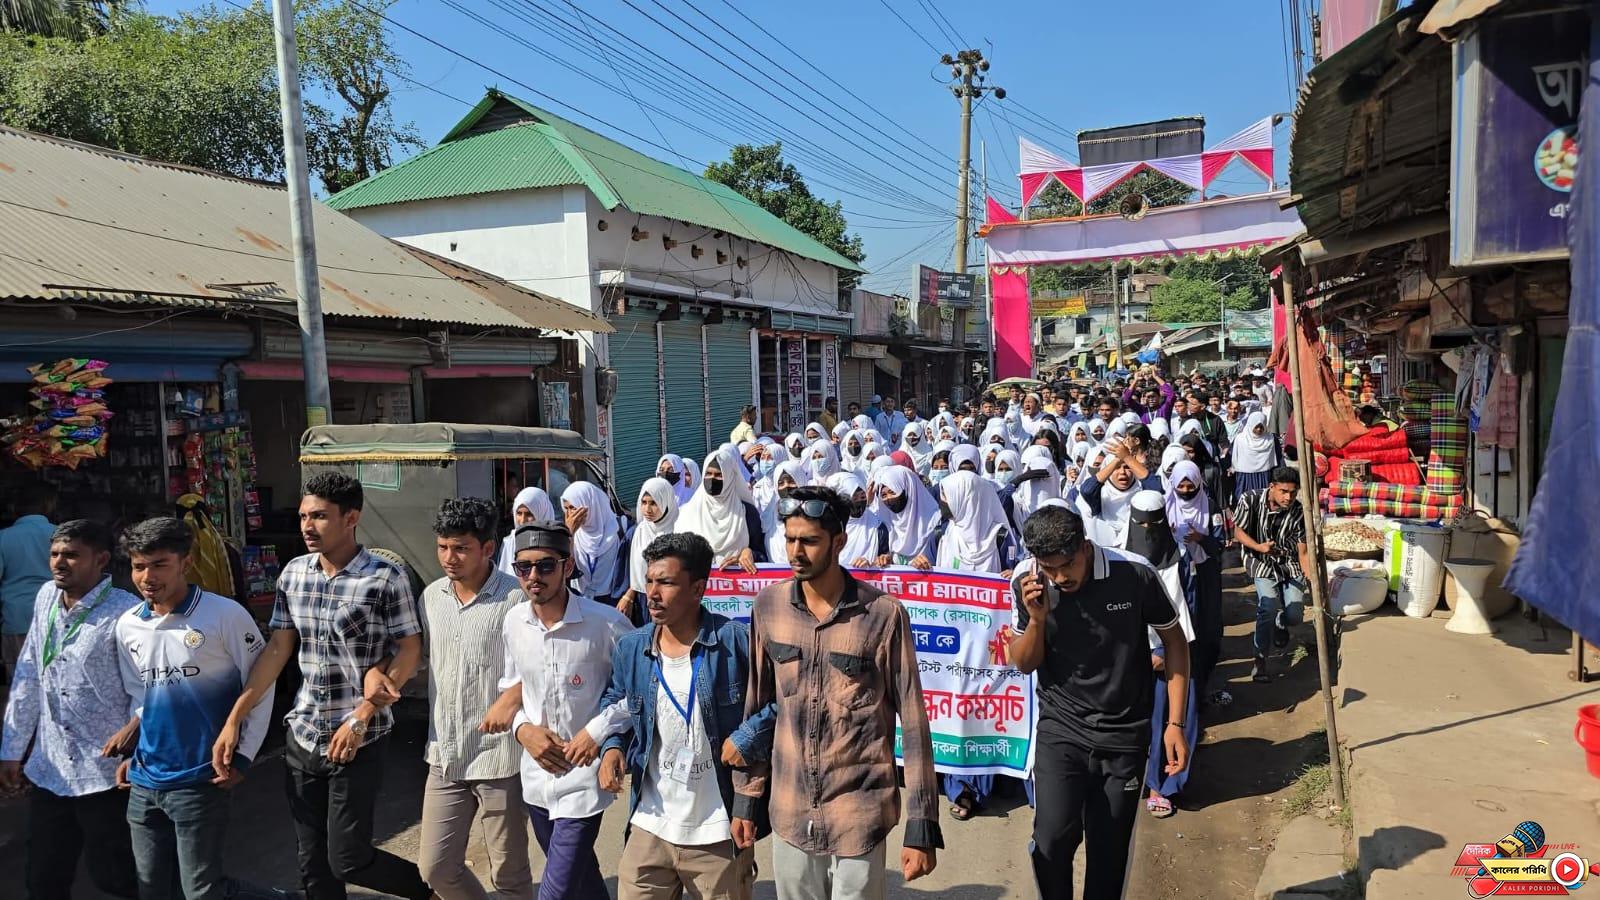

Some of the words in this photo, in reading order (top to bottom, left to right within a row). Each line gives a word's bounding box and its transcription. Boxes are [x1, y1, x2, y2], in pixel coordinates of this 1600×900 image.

[907, 580, 928, 598] না
[932, 583, 998, 605] মানবো
[1106, 602, 1132, 611] Catch
[943, 608, 992, 627] (রসায়ন)
[912, 629, 931, 647] ার
[936, 635, 956, 648] কে
[946, 661, 993, 681] পরীক্ষাসহ
[955, 684, 1025, 733] কর্মসূচি
[963, 740, 1011, 758] শিক্ষার্থী
